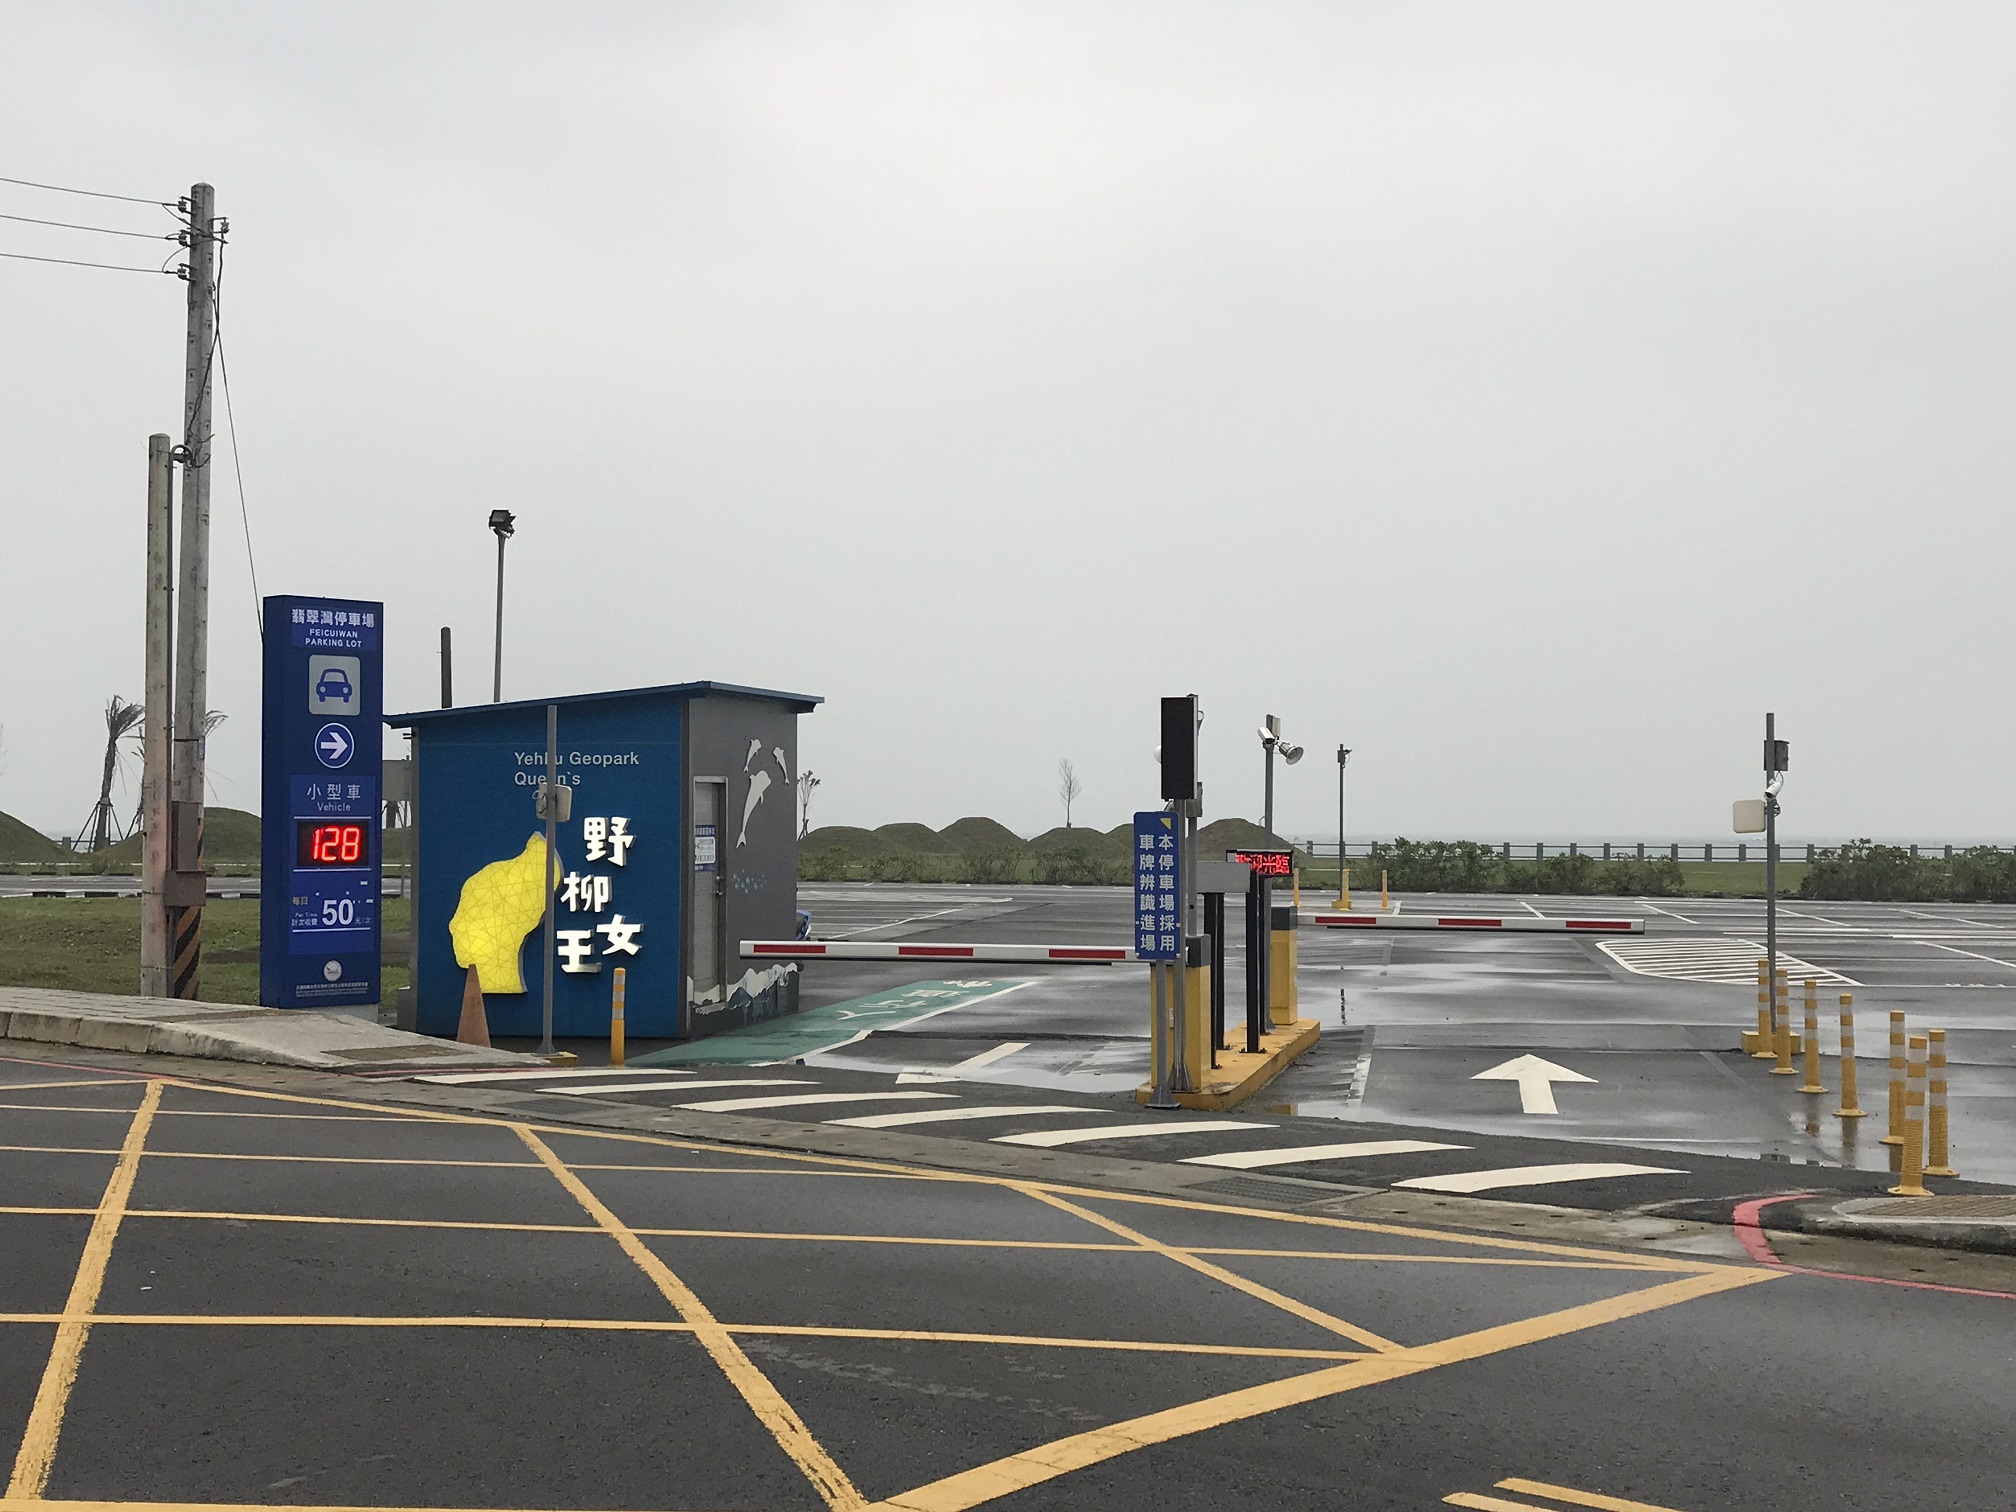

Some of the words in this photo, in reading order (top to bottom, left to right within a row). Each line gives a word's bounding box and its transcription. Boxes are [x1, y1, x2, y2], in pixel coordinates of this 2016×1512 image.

[291, 608, 375, 628] 翡翠灣停車場
[309, 628, 358, 638] FEICUIWAN
[305, 638, 343, 647] PARKING
[514, 751, 563, 766] Yehlu
[569, 751, 639, 768] Geopark
[306, 783, 361, 800] 小型車
[317, 802, 351, 812] Vehicle
[312, 827, 361, 861] 128
[1139, 833, 1156, 952] 車牌辨識進場
[1158, 833, 1175, 952] 本停車場採用
[322, 899, 354, 926] 50
